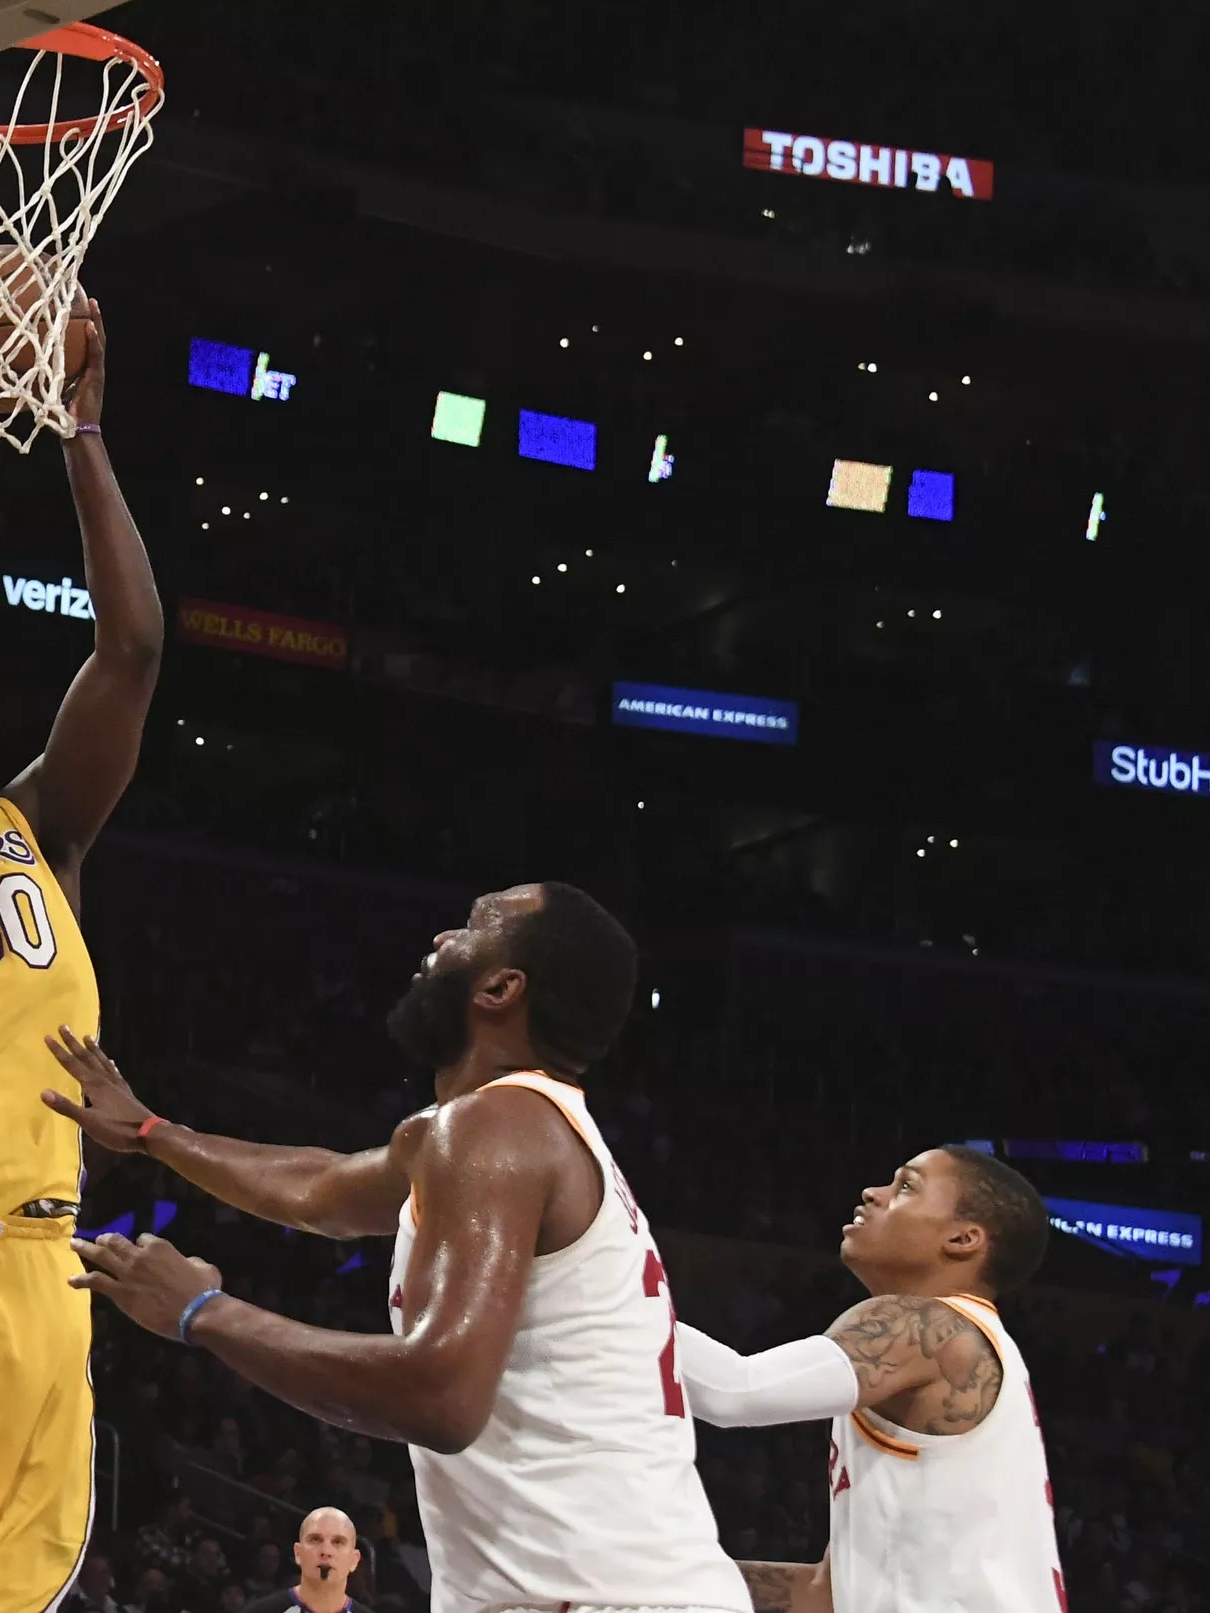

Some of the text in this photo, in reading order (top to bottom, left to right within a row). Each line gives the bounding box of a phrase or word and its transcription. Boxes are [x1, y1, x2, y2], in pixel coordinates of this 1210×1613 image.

[762, 129, 974, 198] TOSHIBA
[2, 574, 96, 621] veriz
[181, 608, 347, 658] WELLS FARGO
[618, 697, 788, 730] AMERICAN EXPRESS
[1106, 1223, 1194, 1249] EXPRESS
